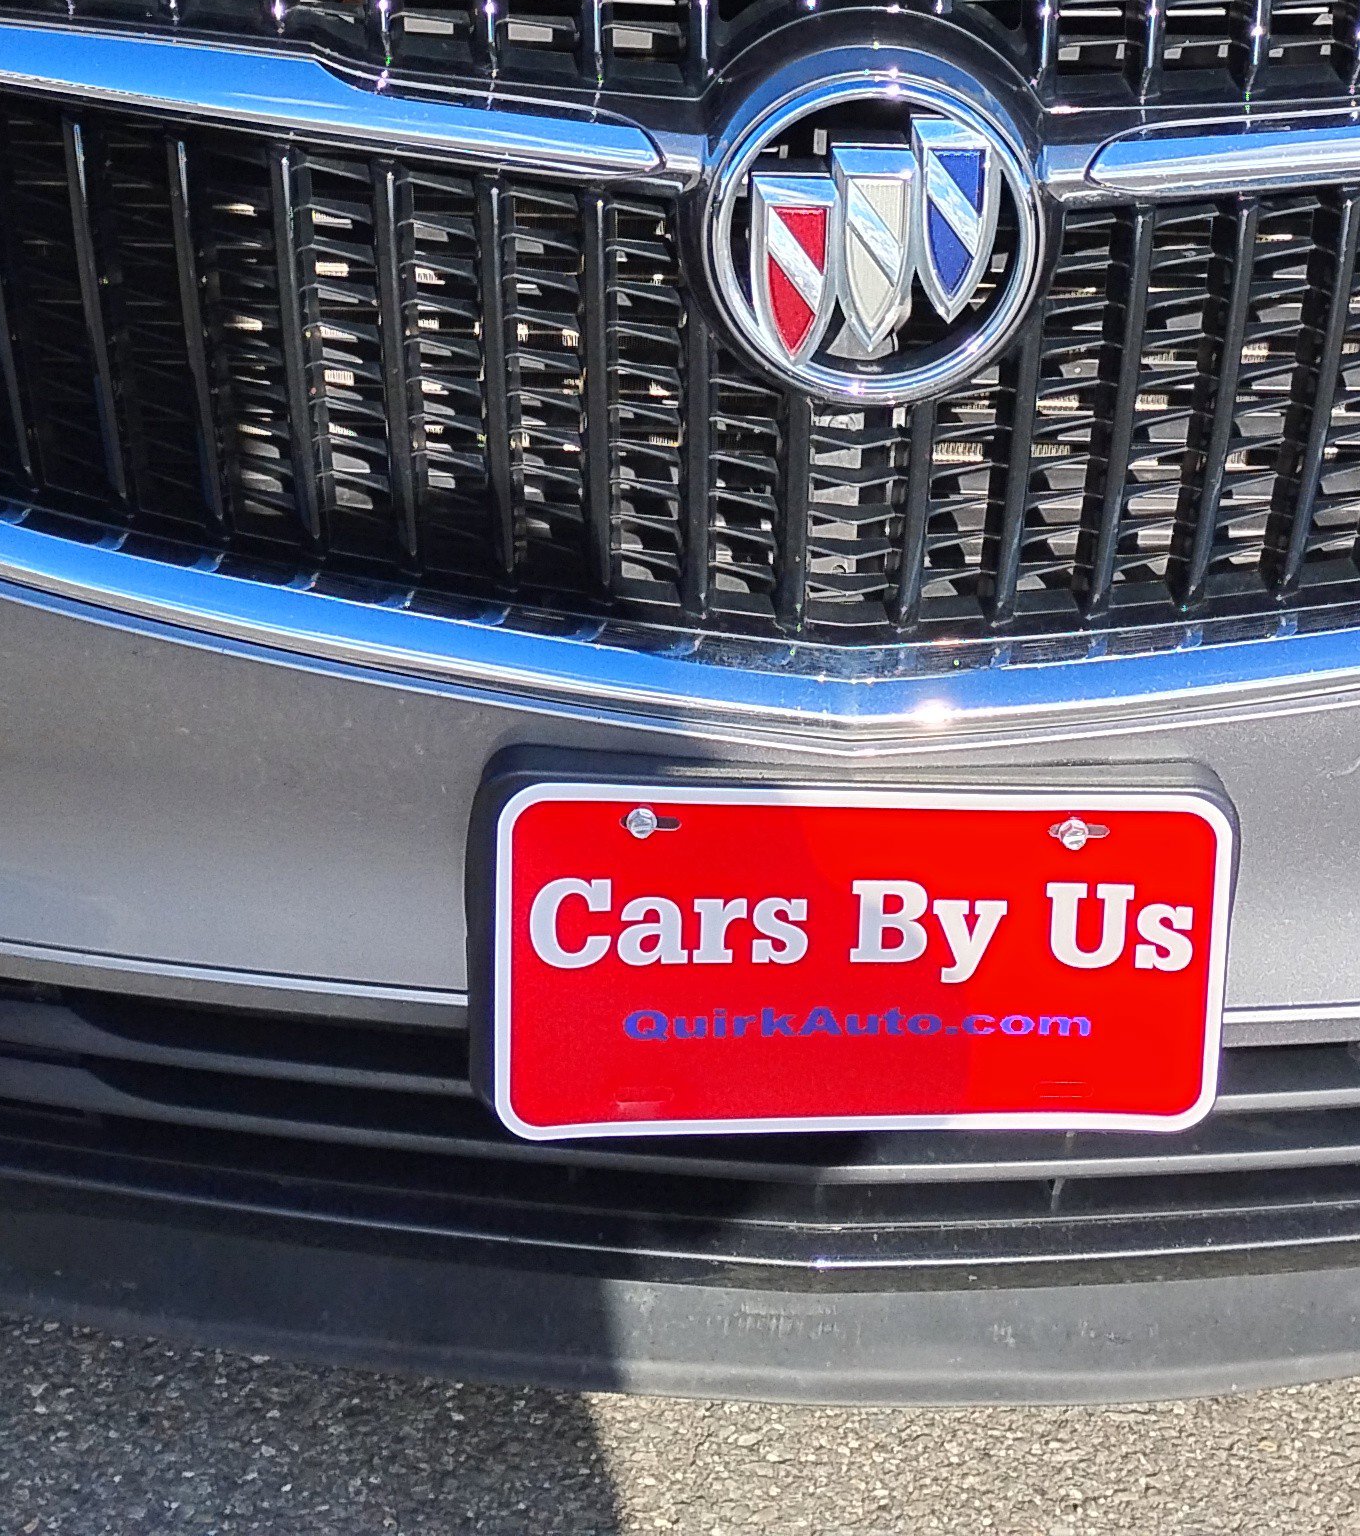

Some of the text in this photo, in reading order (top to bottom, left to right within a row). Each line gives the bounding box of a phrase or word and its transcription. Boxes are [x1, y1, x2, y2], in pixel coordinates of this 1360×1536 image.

[528, 877, 1194, 984] Cars By Us
[622, 1006, 1093, 1043] QuirkAuto.com
